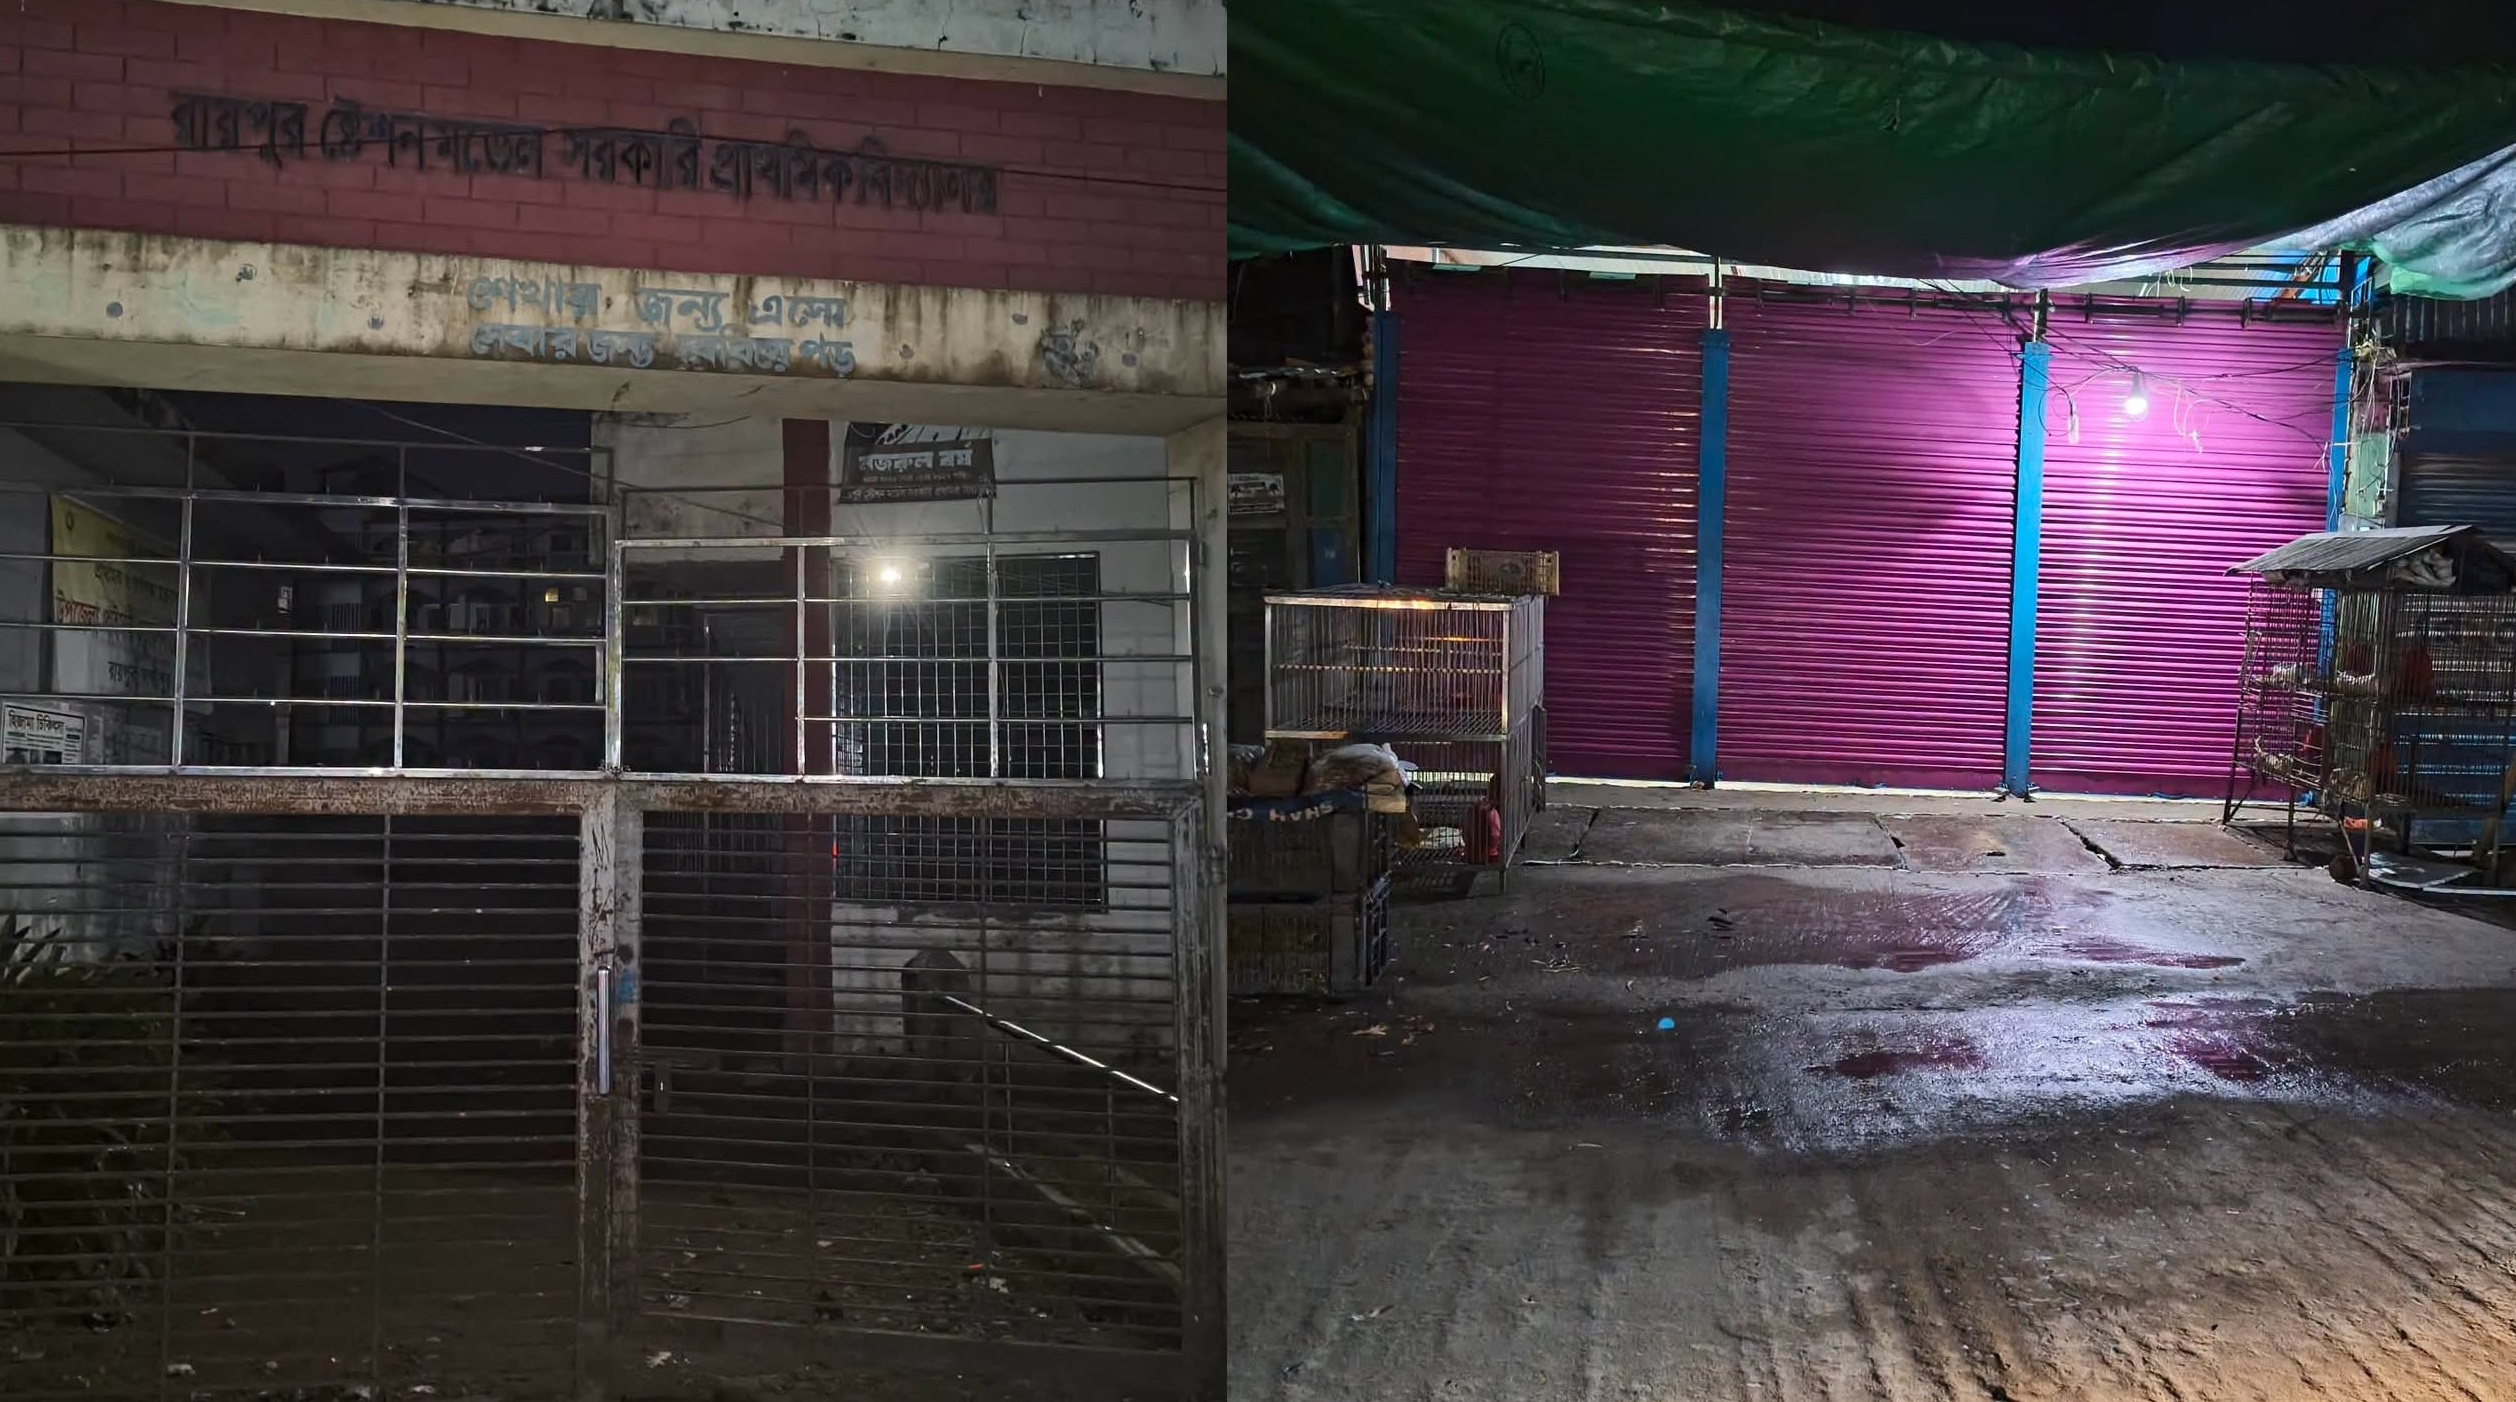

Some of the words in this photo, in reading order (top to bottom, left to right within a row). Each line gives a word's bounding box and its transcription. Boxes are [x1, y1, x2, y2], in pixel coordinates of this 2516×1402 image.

[561, 116, 702, 191] সরকারি
[709, 130, 853, 203] প্রাথমিক
[634, 286, 731, 334] জন্য
